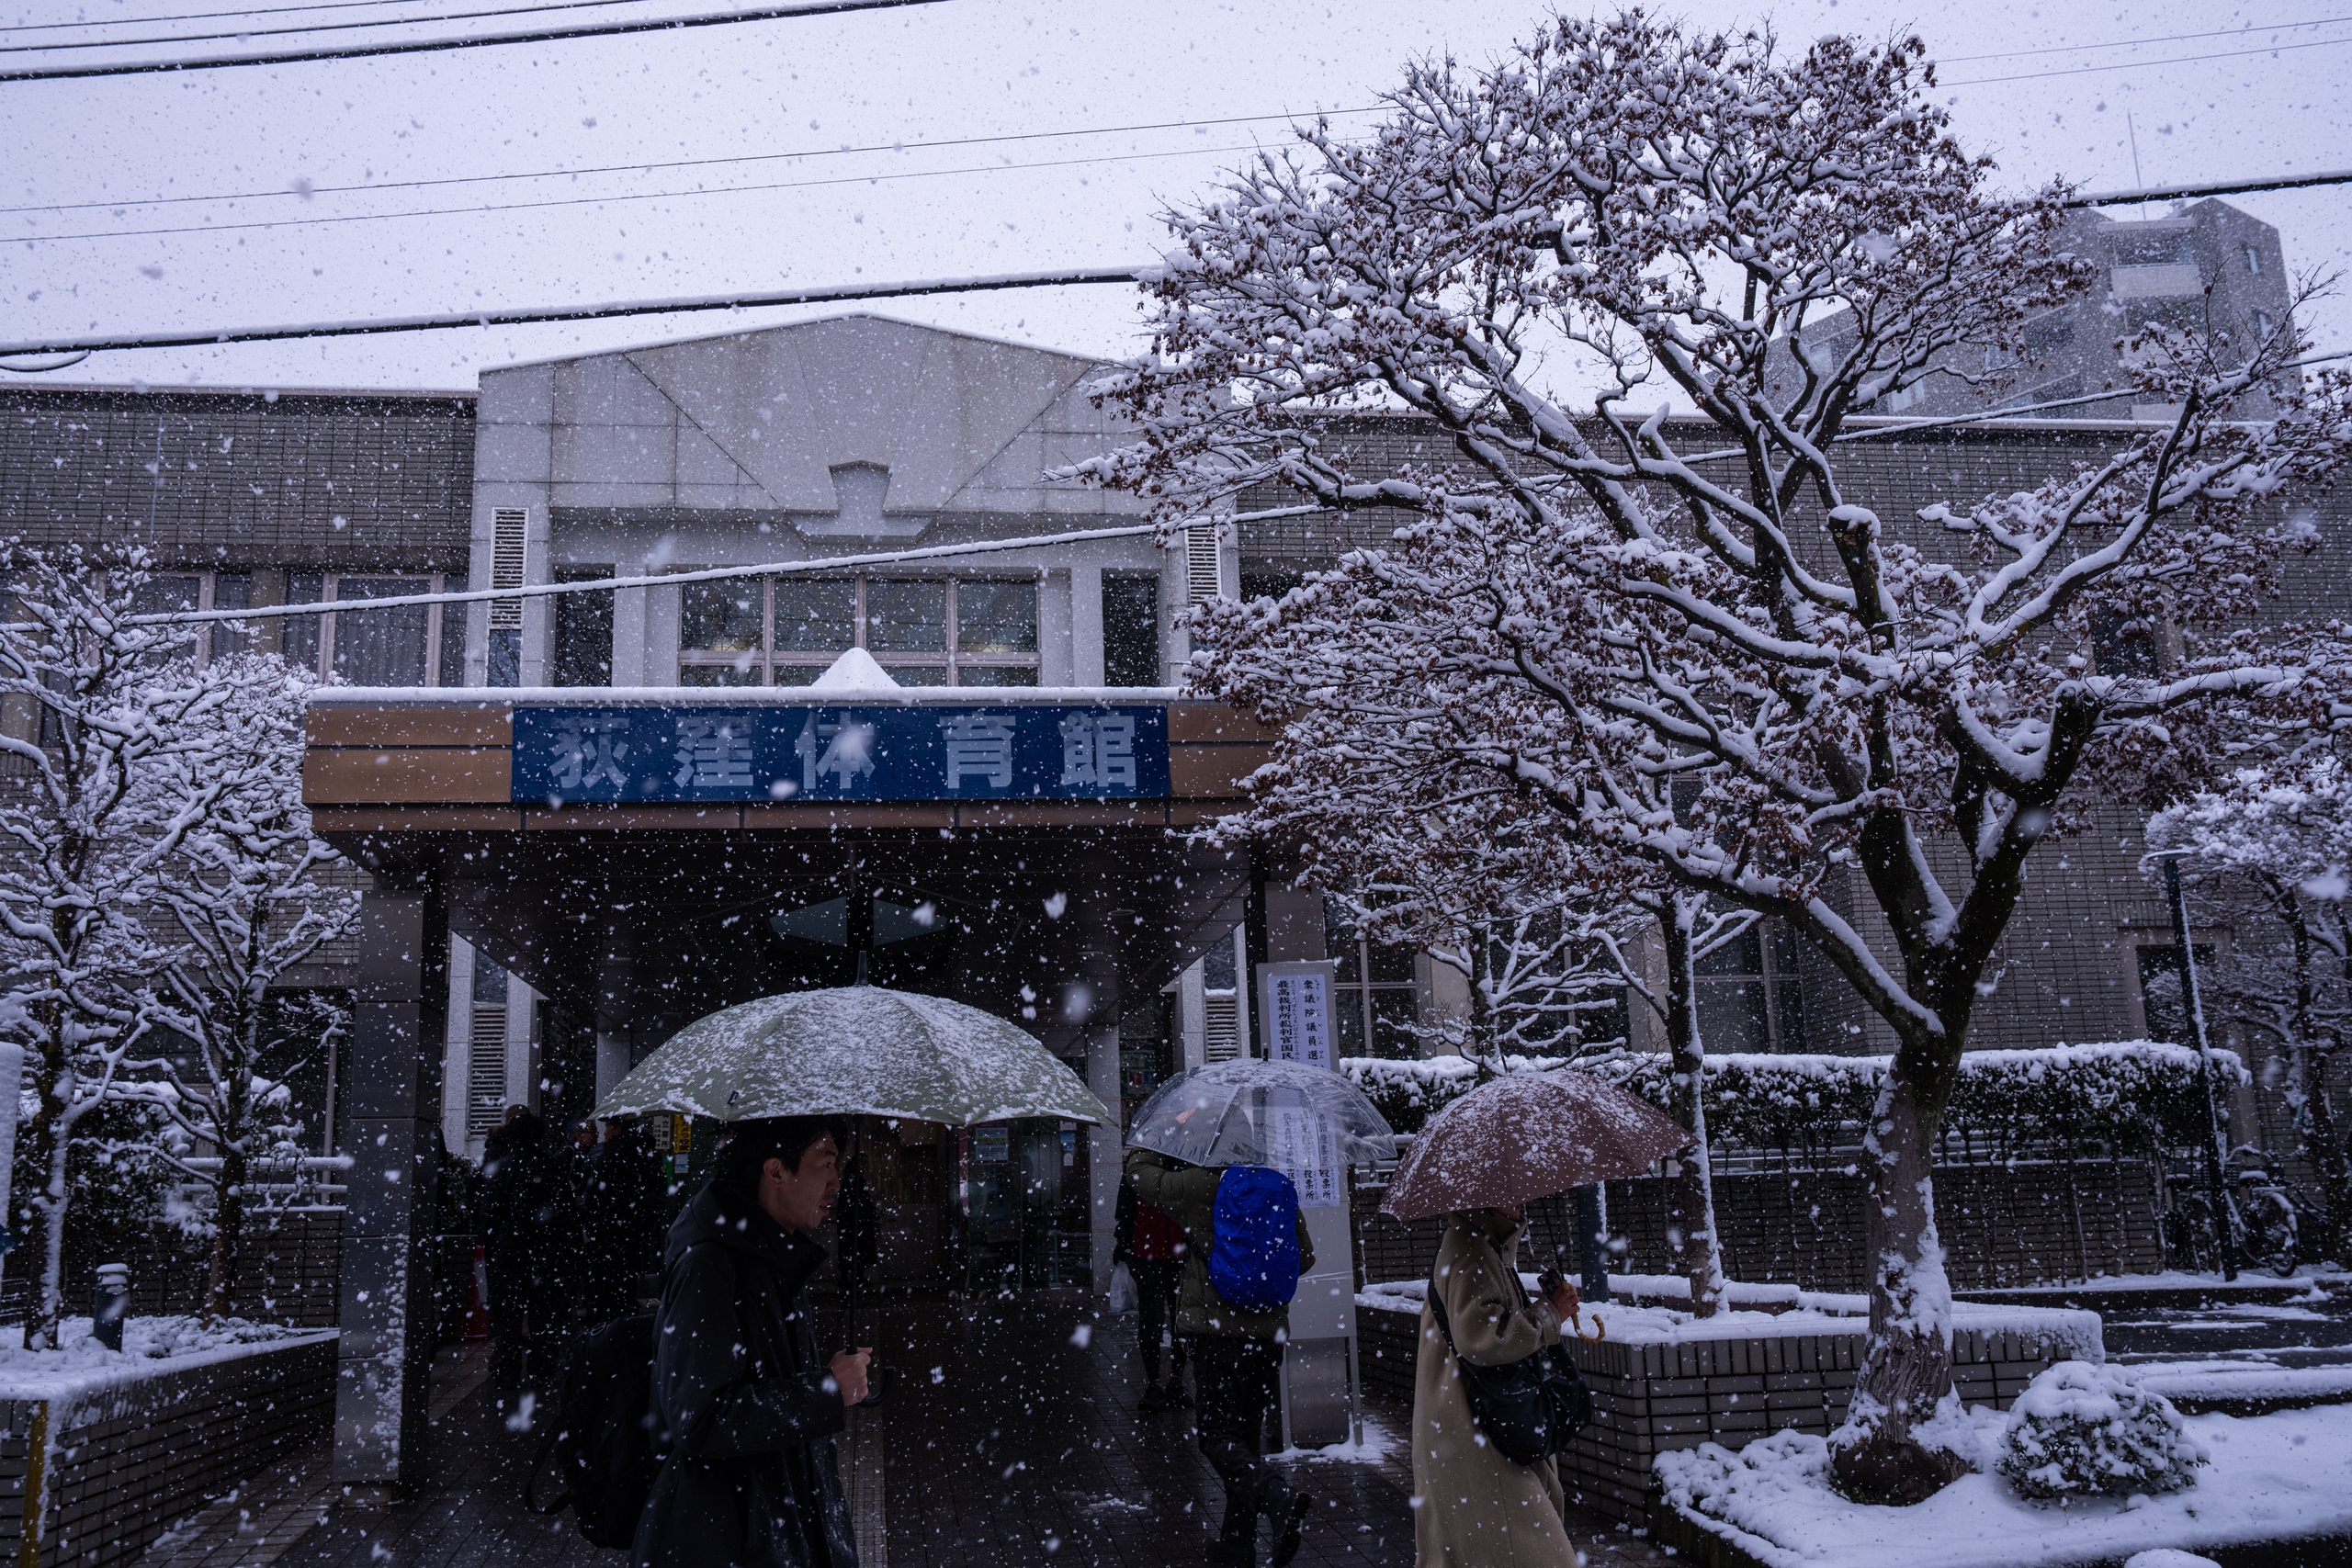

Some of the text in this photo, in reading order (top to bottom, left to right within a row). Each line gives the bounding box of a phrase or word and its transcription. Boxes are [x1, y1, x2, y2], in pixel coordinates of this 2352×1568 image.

[548, 710, 1136, 790] 荻窪体育館
[1276, 980, 1294, 1060] 最高裁判所裁判官国民
[1303, 979, 1319, 1067] 衆議院議員選
